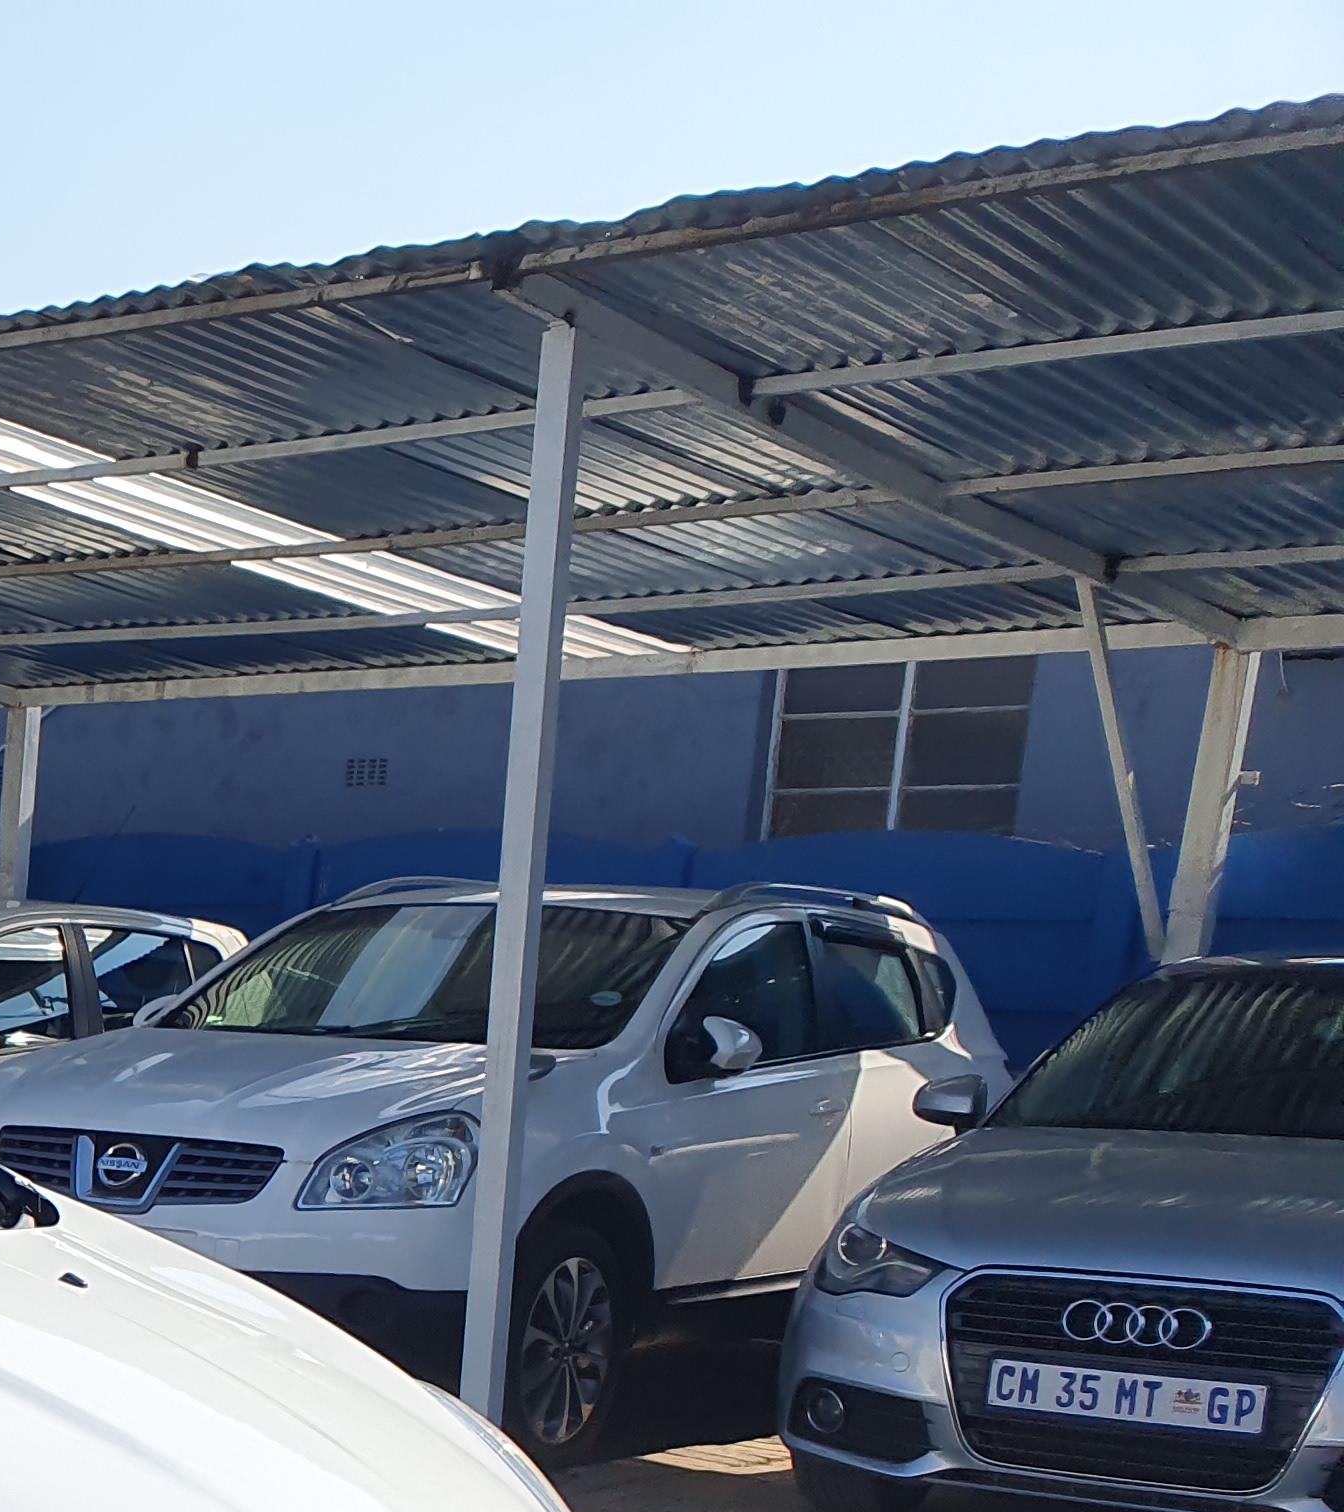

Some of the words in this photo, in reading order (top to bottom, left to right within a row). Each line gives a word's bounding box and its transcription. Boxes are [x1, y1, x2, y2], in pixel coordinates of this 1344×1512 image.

[99, 1159, 140, 1170] NISSAN
[996, 1364, 1041, 1405] CM
[1055, 1370, 1101, 1411] 35
[1113, 1377, 1163, 1418] MT
[1206, 1386, 1257, 1427] GP
